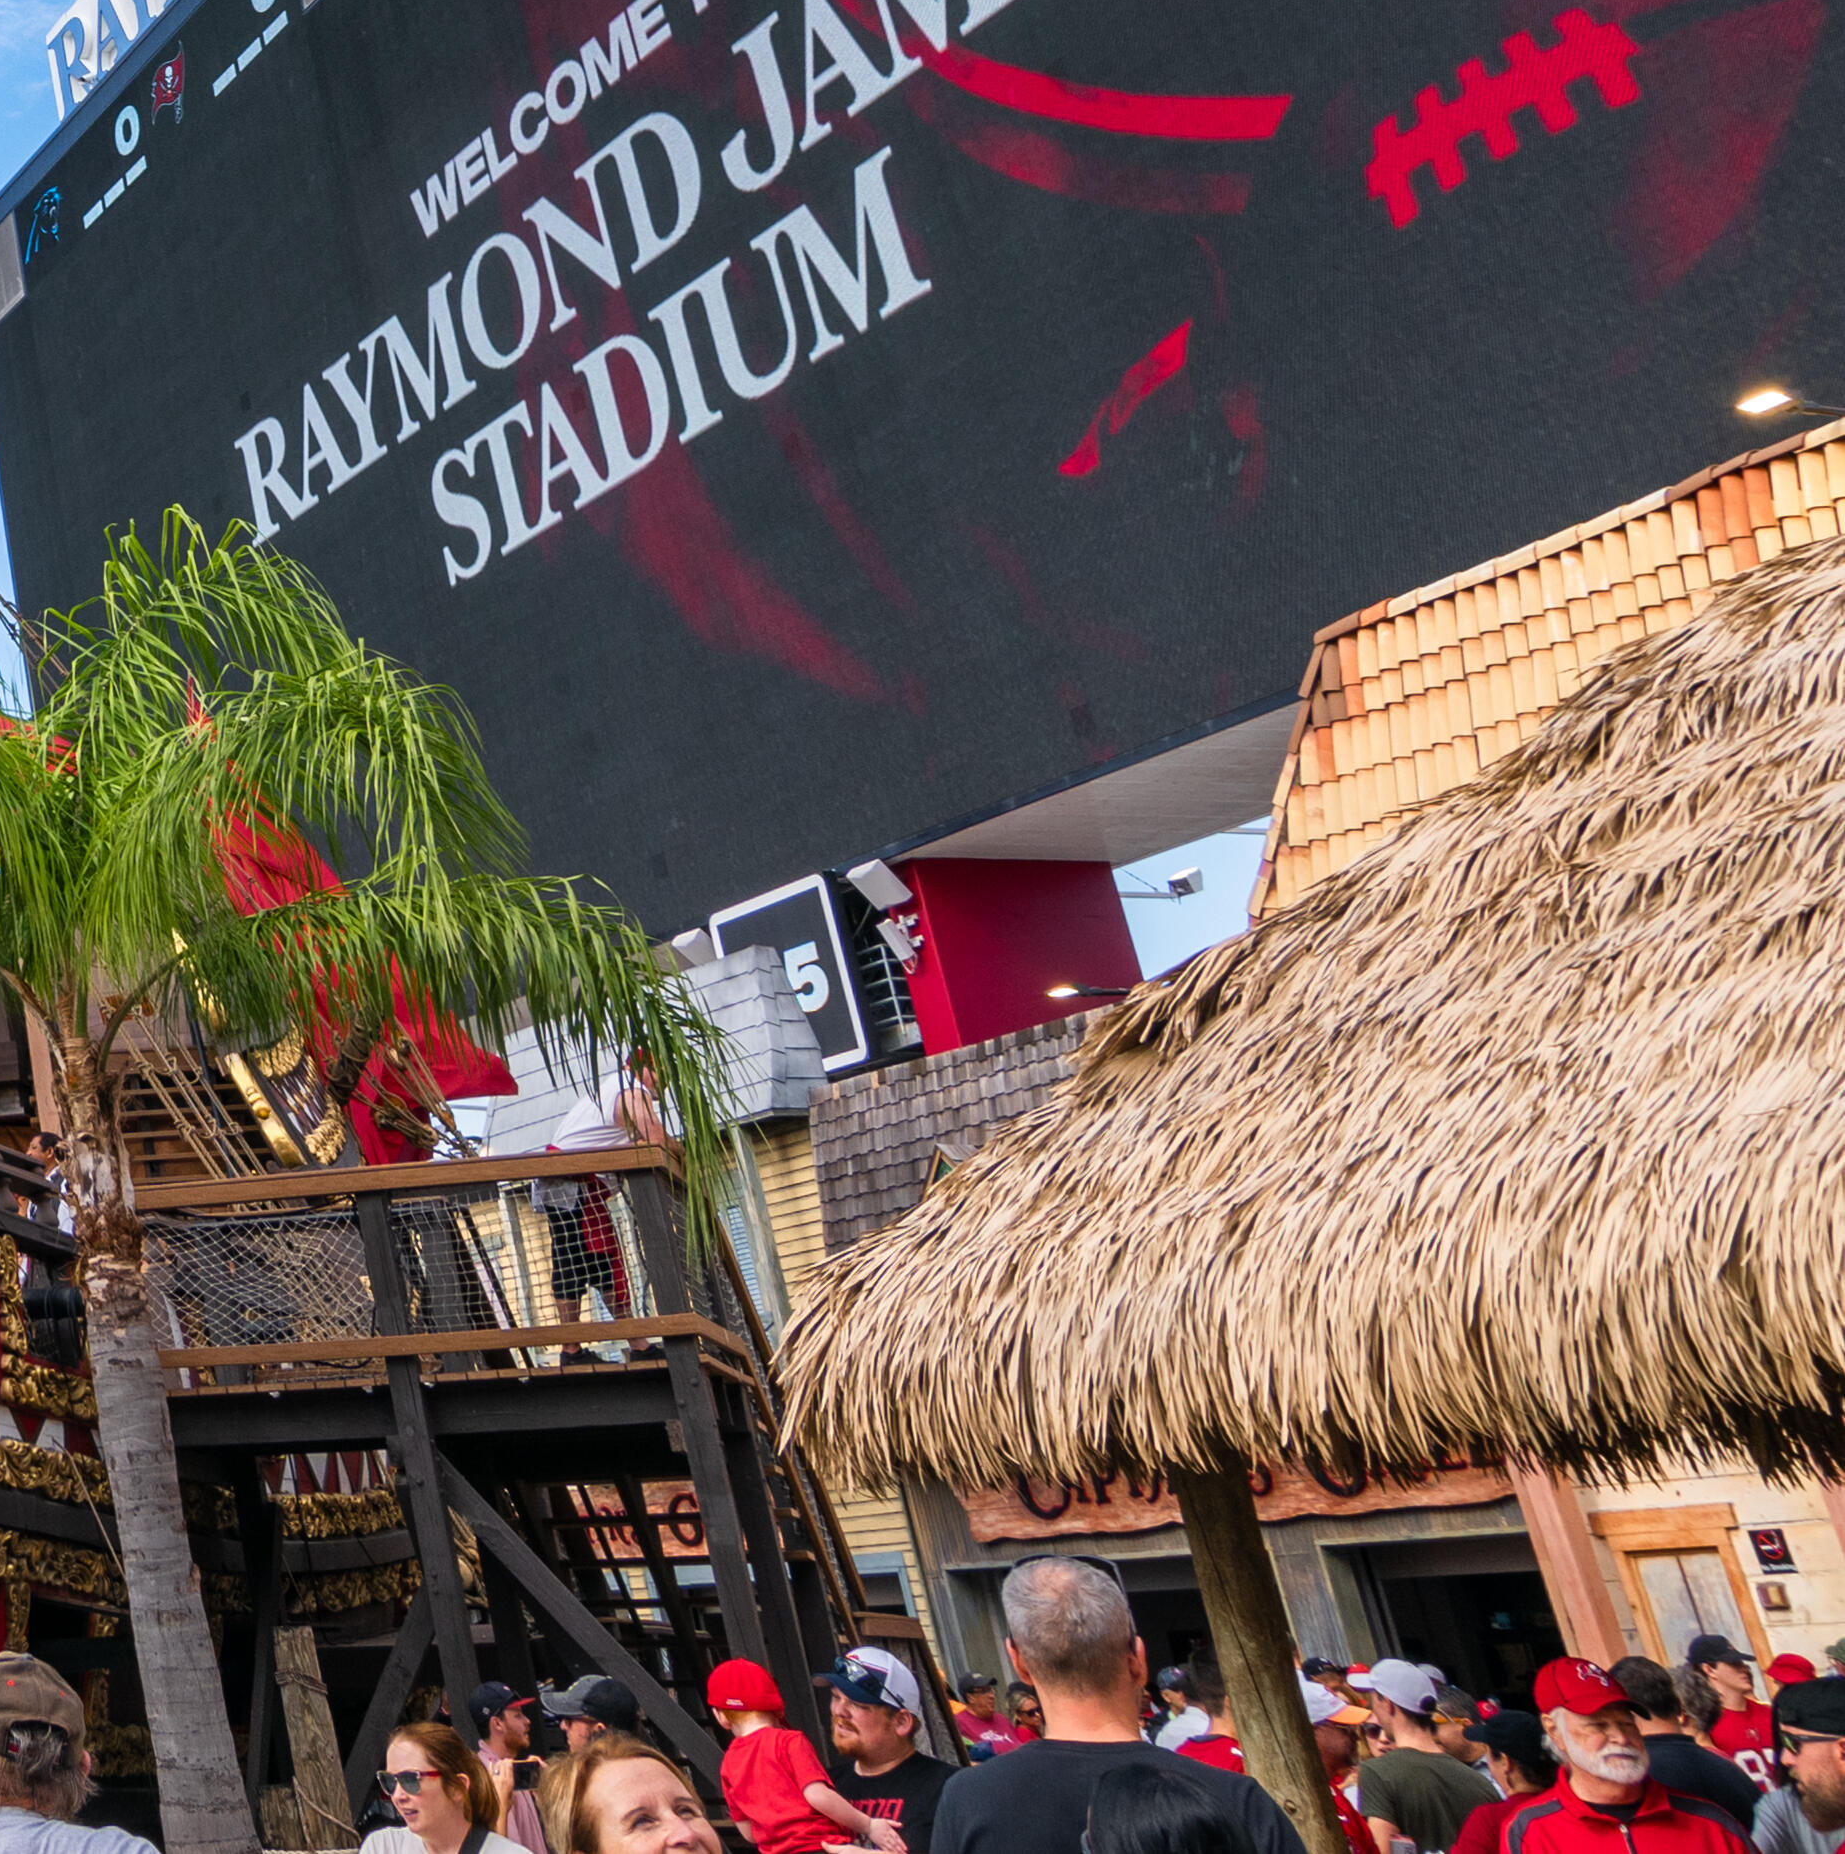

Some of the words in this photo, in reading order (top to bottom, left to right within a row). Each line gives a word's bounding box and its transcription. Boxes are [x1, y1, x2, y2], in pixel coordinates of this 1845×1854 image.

[114, 104, 141, 157] 0
[232, 112, 703, 548] RAYMOND
[429, 146, 932, 588] STADIUM
